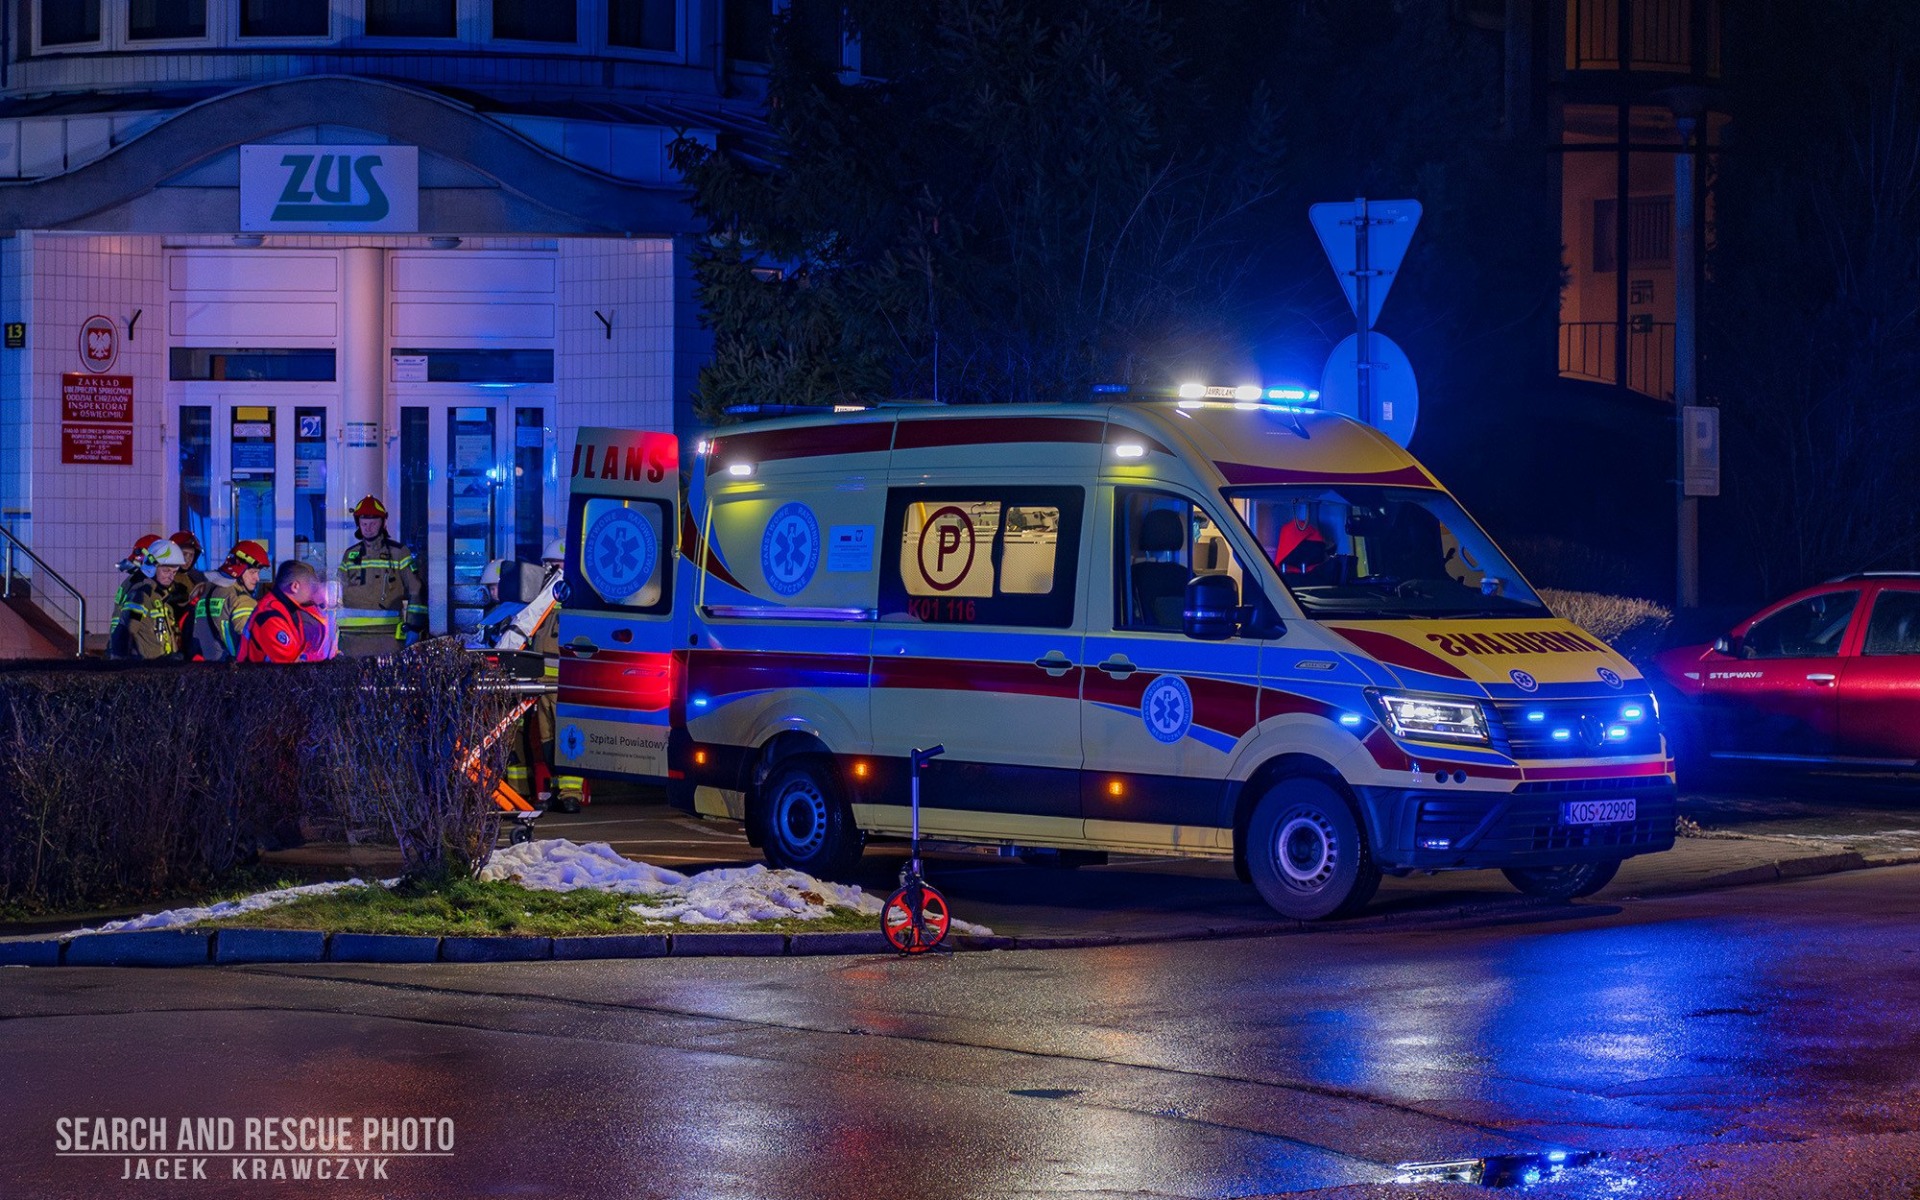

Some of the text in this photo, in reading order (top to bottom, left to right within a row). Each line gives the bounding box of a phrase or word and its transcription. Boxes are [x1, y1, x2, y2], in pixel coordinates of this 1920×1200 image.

[270, 154, 390, 222] ZUS
[7, 324, 23, 339] 13
[78, 378, 119, 387] ZAKŁAD
[68, 402, 127, 410] INSPEKTORAT
[94, 395, 129, 403] CHRZANÓW
[937, 525, 961, 572] P
[908, 600, 976, 620] K01 116
[589, 733, 667, 751] Szpital Powiatowy
[1571, 801, 1635, 823] KOS 2299G
